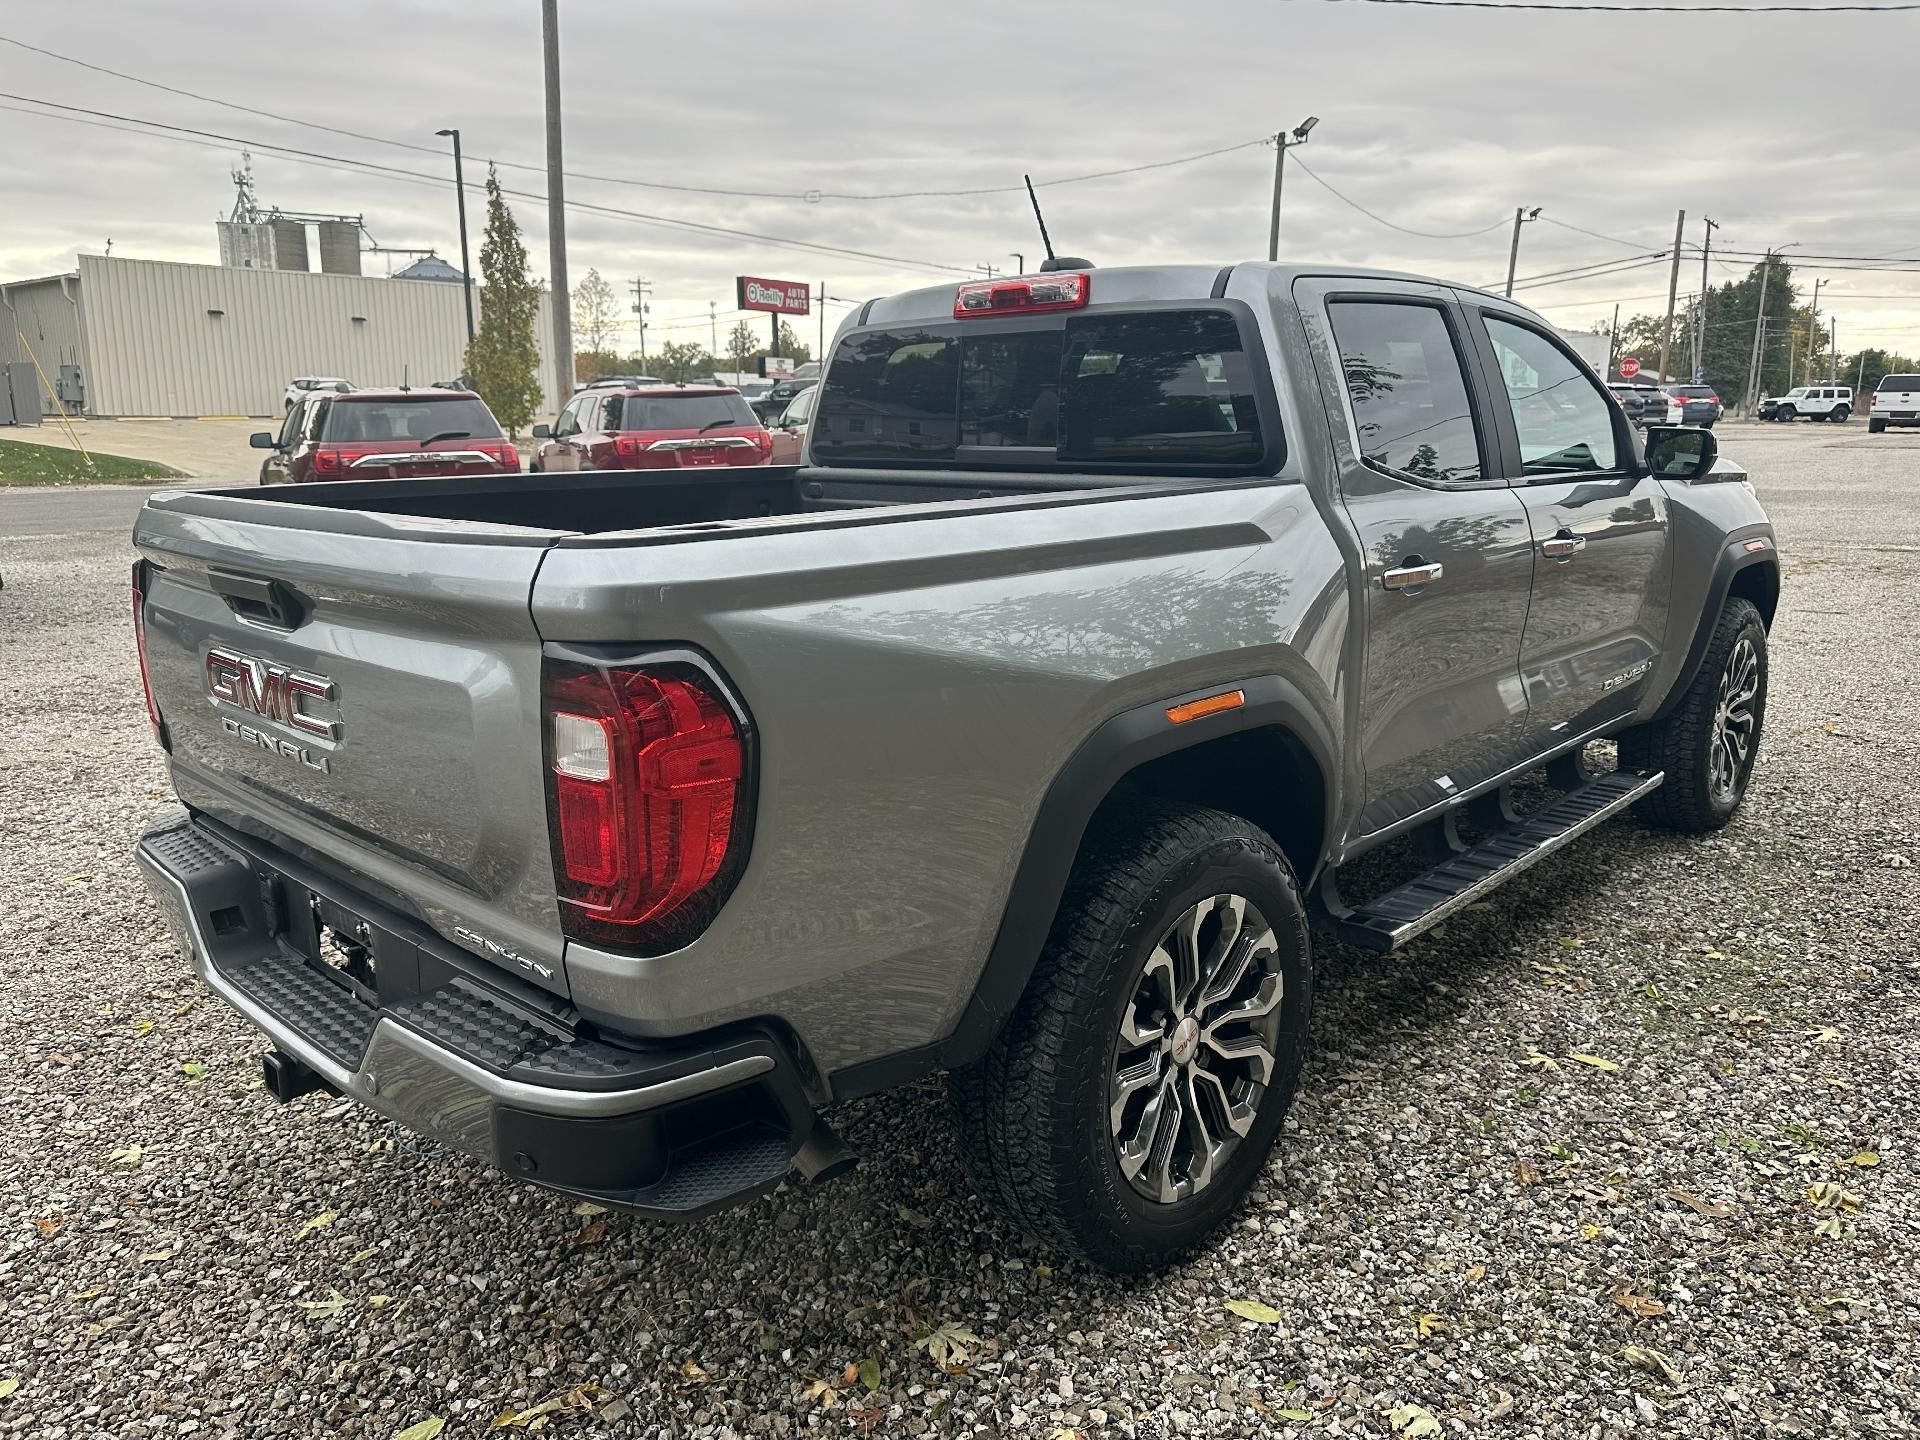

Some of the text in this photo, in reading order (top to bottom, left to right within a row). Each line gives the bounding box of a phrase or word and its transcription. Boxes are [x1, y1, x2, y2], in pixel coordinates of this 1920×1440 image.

[785, 298, 808, 310] PARTS
[787, 288, 806, 299] AUTO
[1621, 363, 1639, 372] STOP
[1602, 661, 1652, 691] DENALI
[206, 649, 344, 740] GMC
[222, 717, 330, 774] DENALI
[454, 926, 554, 980] CANYON
[1175, 1026, 1198, 1056] GMC
